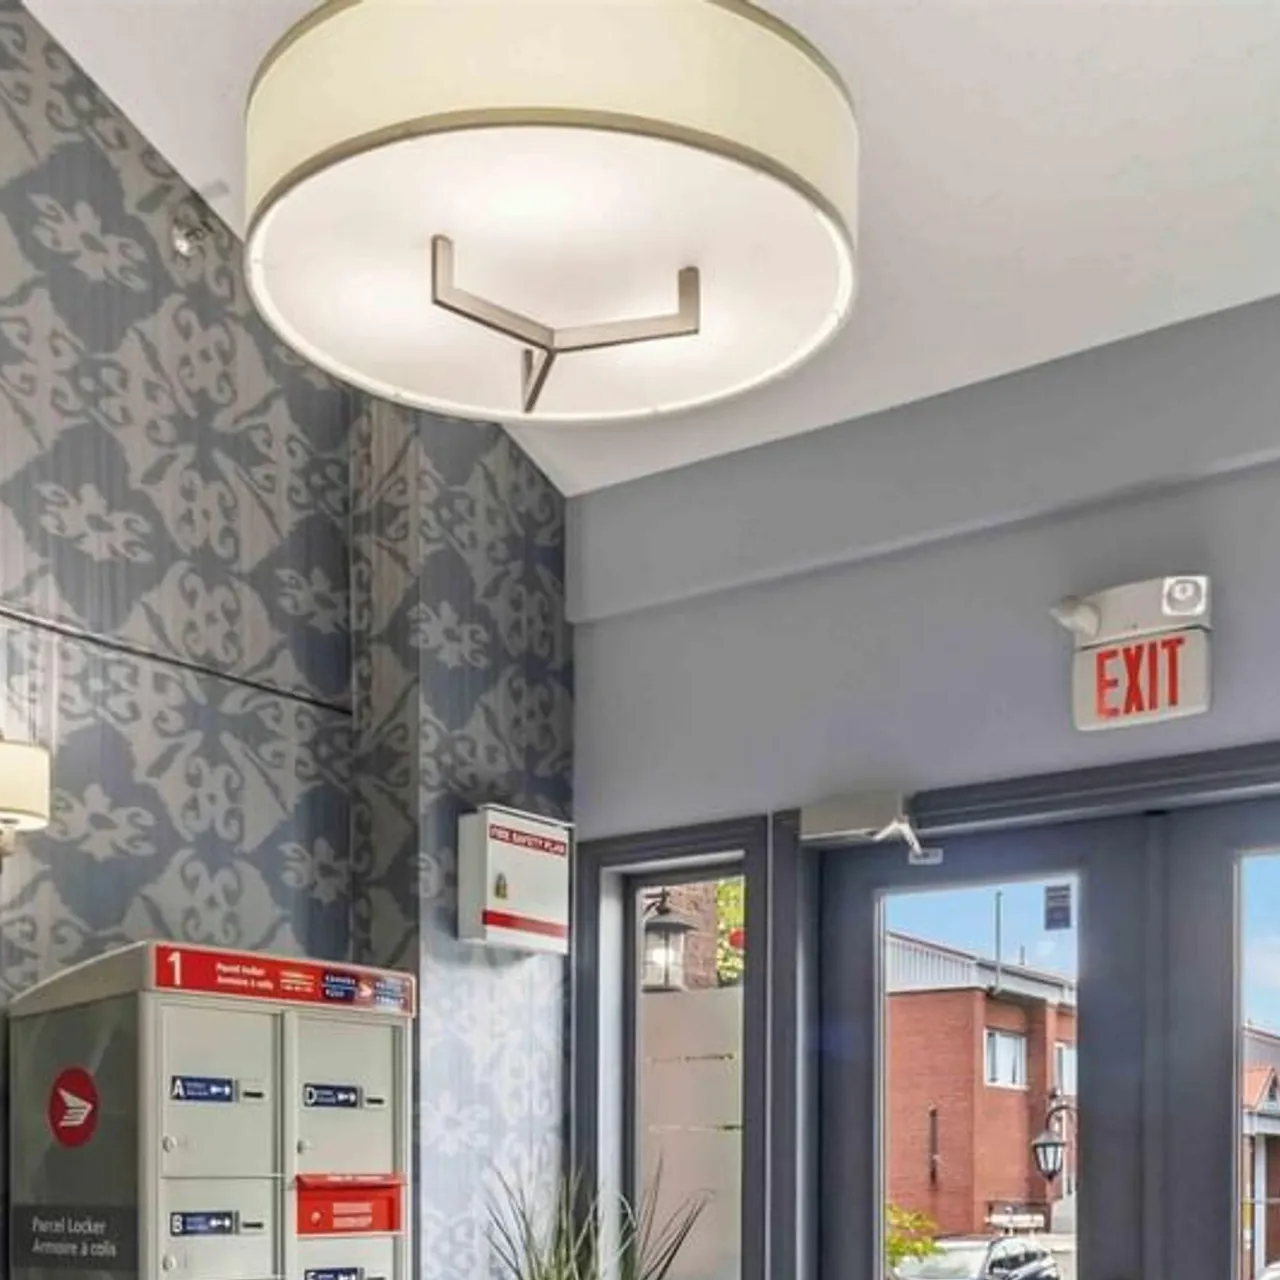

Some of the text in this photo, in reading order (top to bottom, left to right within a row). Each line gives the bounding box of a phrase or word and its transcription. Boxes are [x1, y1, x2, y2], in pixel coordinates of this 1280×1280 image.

[1096, 637, 1185, 718] EXIT
[167, 951, 181, 986] 1
[172, 1078, 185, 1097] A
[306, 1086, 317, 1104] D
[32, 1216, 107, 1235] Parcel Locker
[172, 1214, 182, 1232] B
